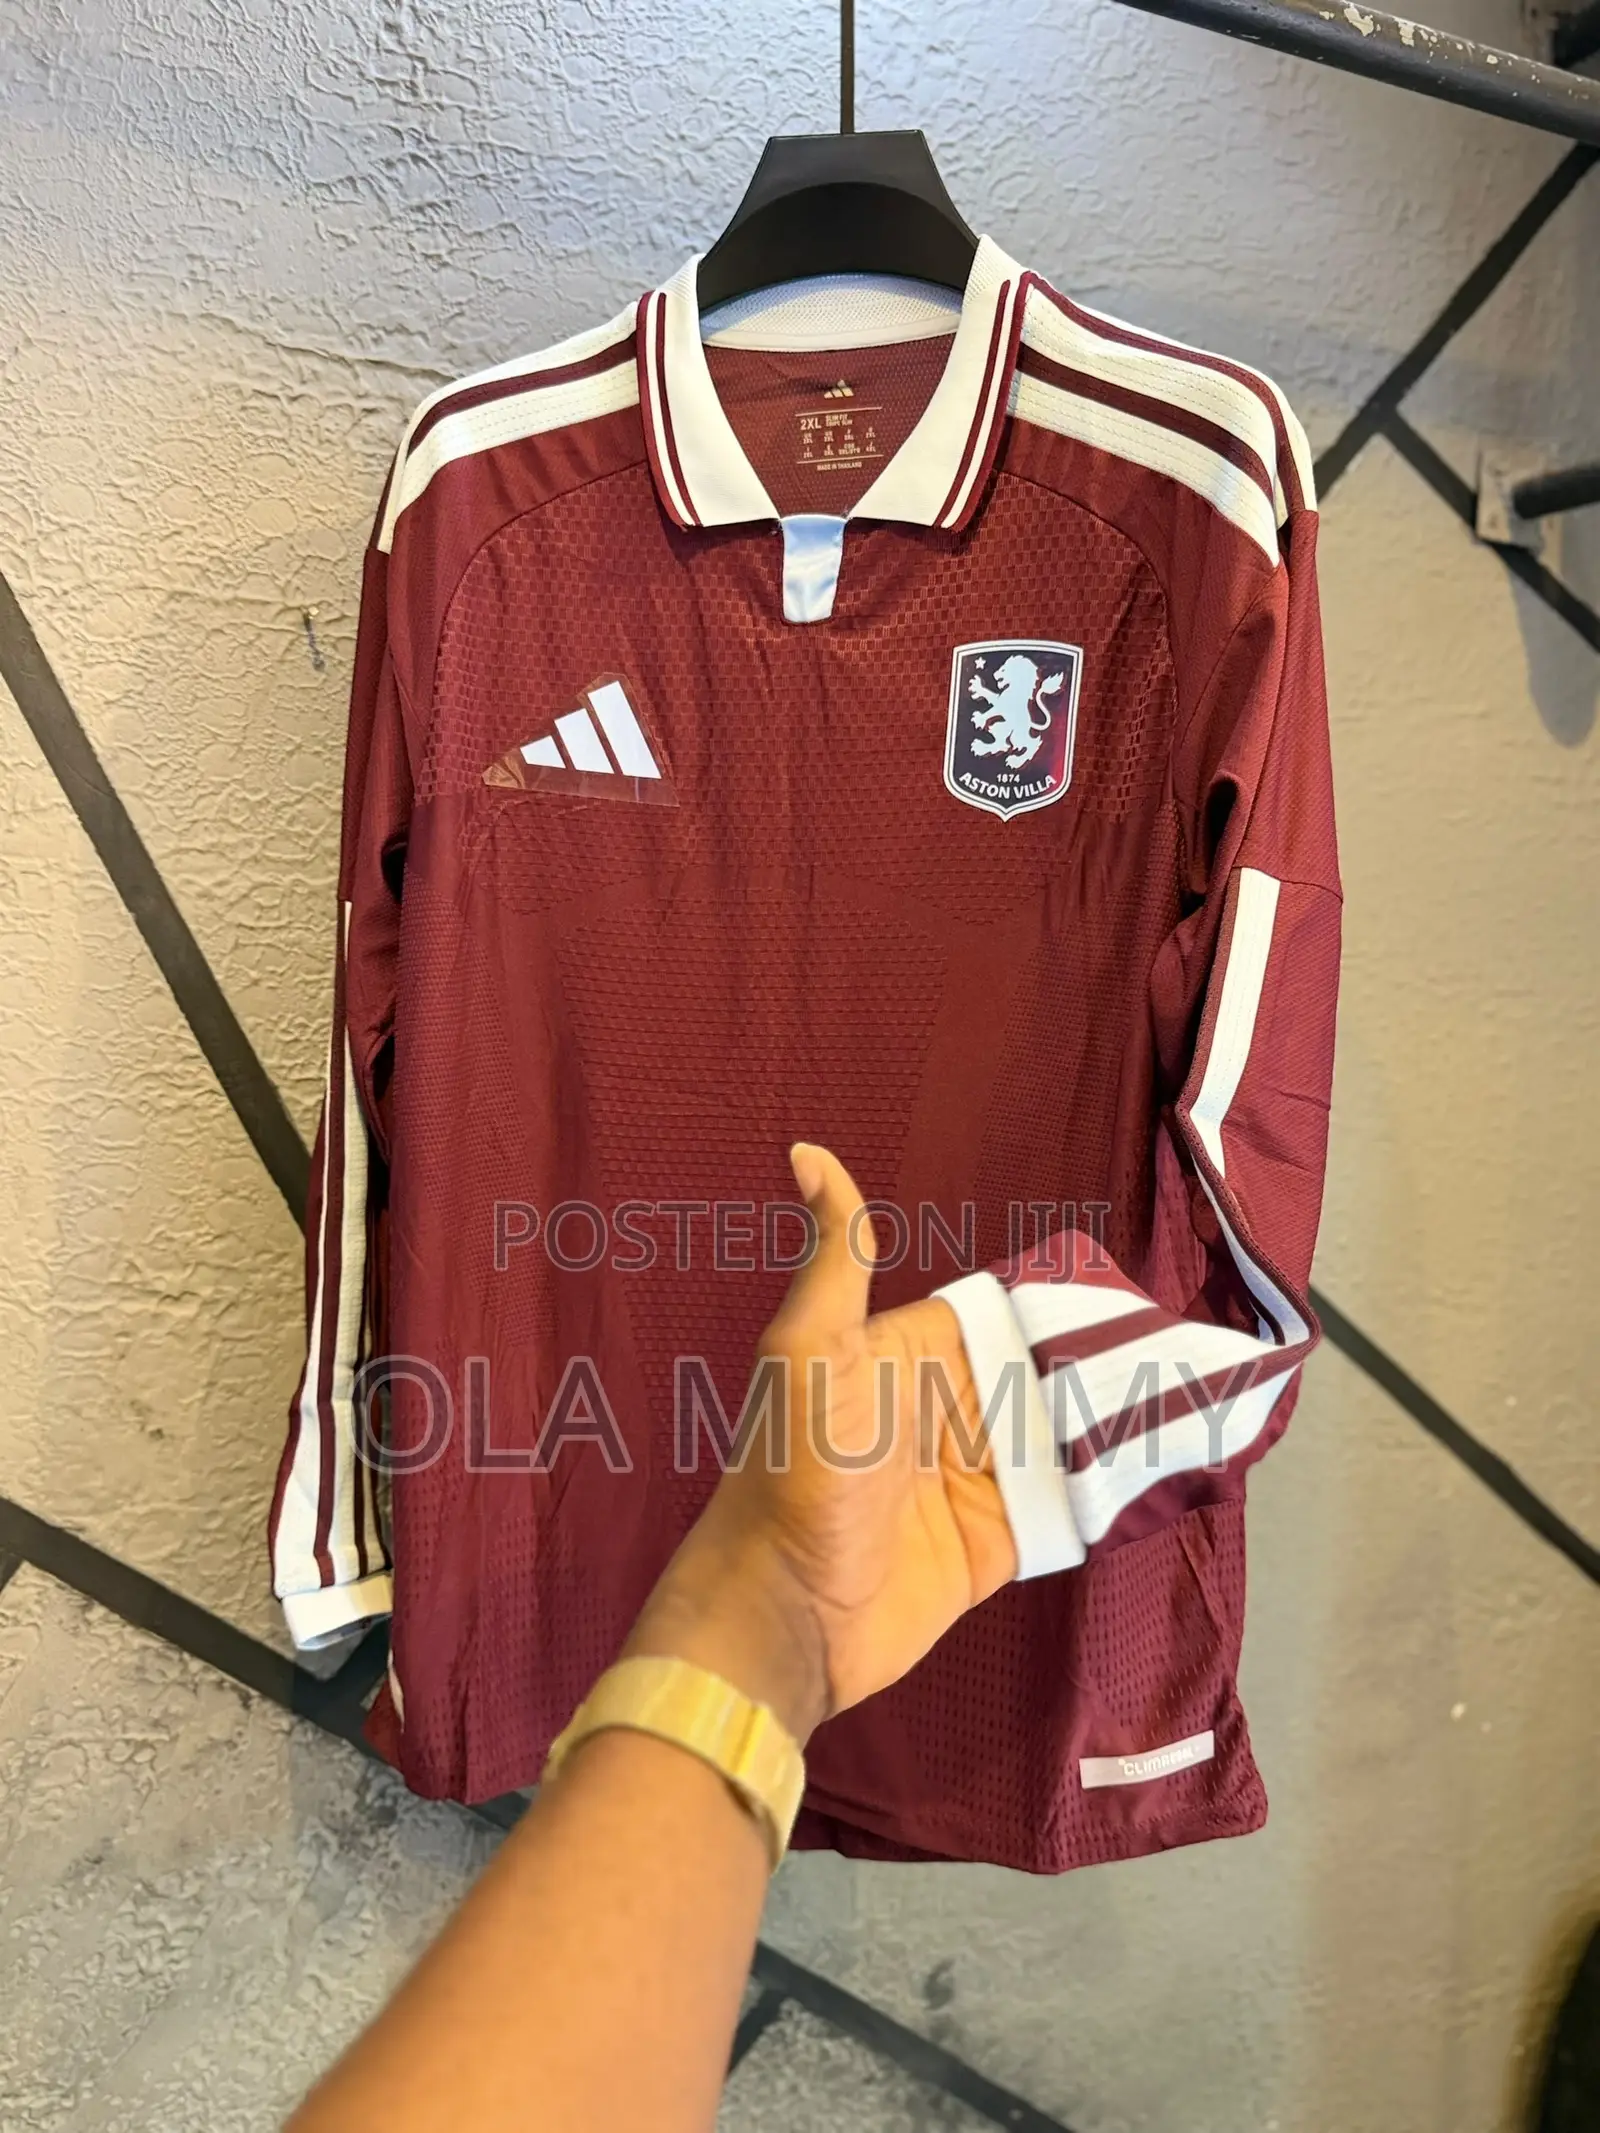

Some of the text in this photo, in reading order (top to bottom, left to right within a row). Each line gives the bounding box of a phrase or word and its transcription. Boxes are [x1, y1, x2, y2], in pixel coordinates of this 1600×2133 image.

[800, 417, 822, 431] 2XL
[958, 772, 1057, 799] ASTON VILLA
[996, 773, 1021, 784] 1874
